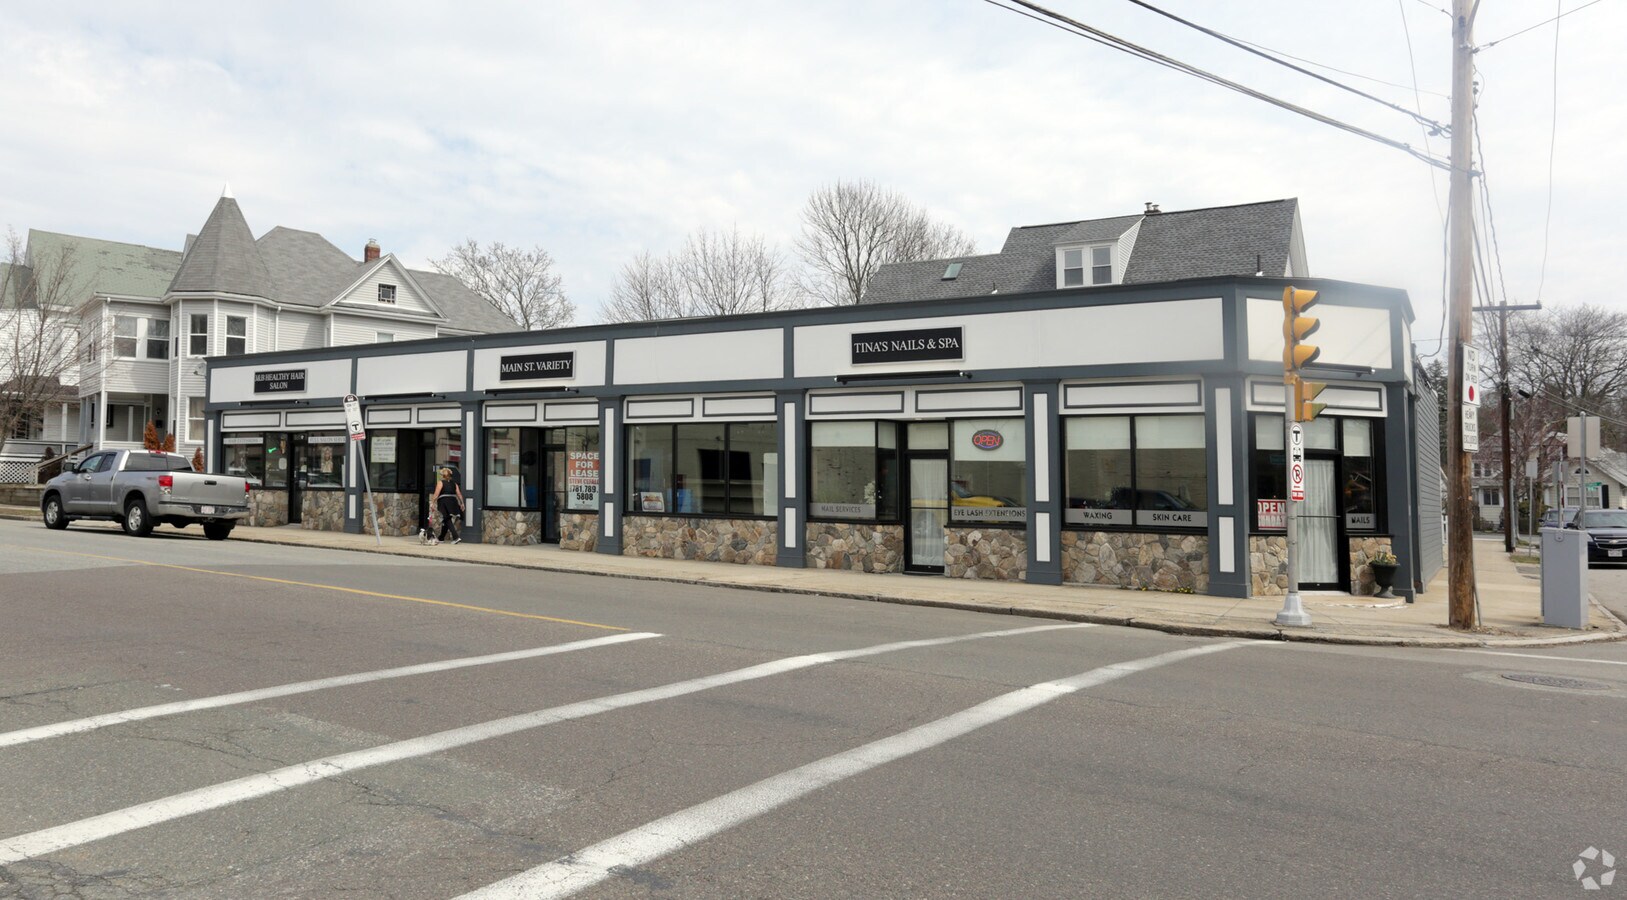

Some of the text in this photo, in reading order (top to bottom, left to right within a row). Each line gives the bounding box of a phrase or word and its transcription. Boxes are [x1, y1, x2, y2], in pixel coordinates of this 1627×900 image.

[853, 337, 959, 353] TINA'S NAILS & SPA
[501, 360, 571, 373] MAIN ST. VARIETY
[265, 372, 290, 381] HEALTHY
[269, 381, 288, 389] SALON
[351, 423, 359, 431] T
[973, 434, 1001, 446] OPEN
[1293, 430, 1300, 442] T
[570, 452, 599, 460] SPACE
[836, 505, 861, 513] SERVICES
[985, 509, 1026, 517] EXTENSIONS
[1083, 511, 1112, 520] WAXING
[1152, 513, 1192, 522] SKIN CARE
[1351, 516, 1370, 524] NAILS
